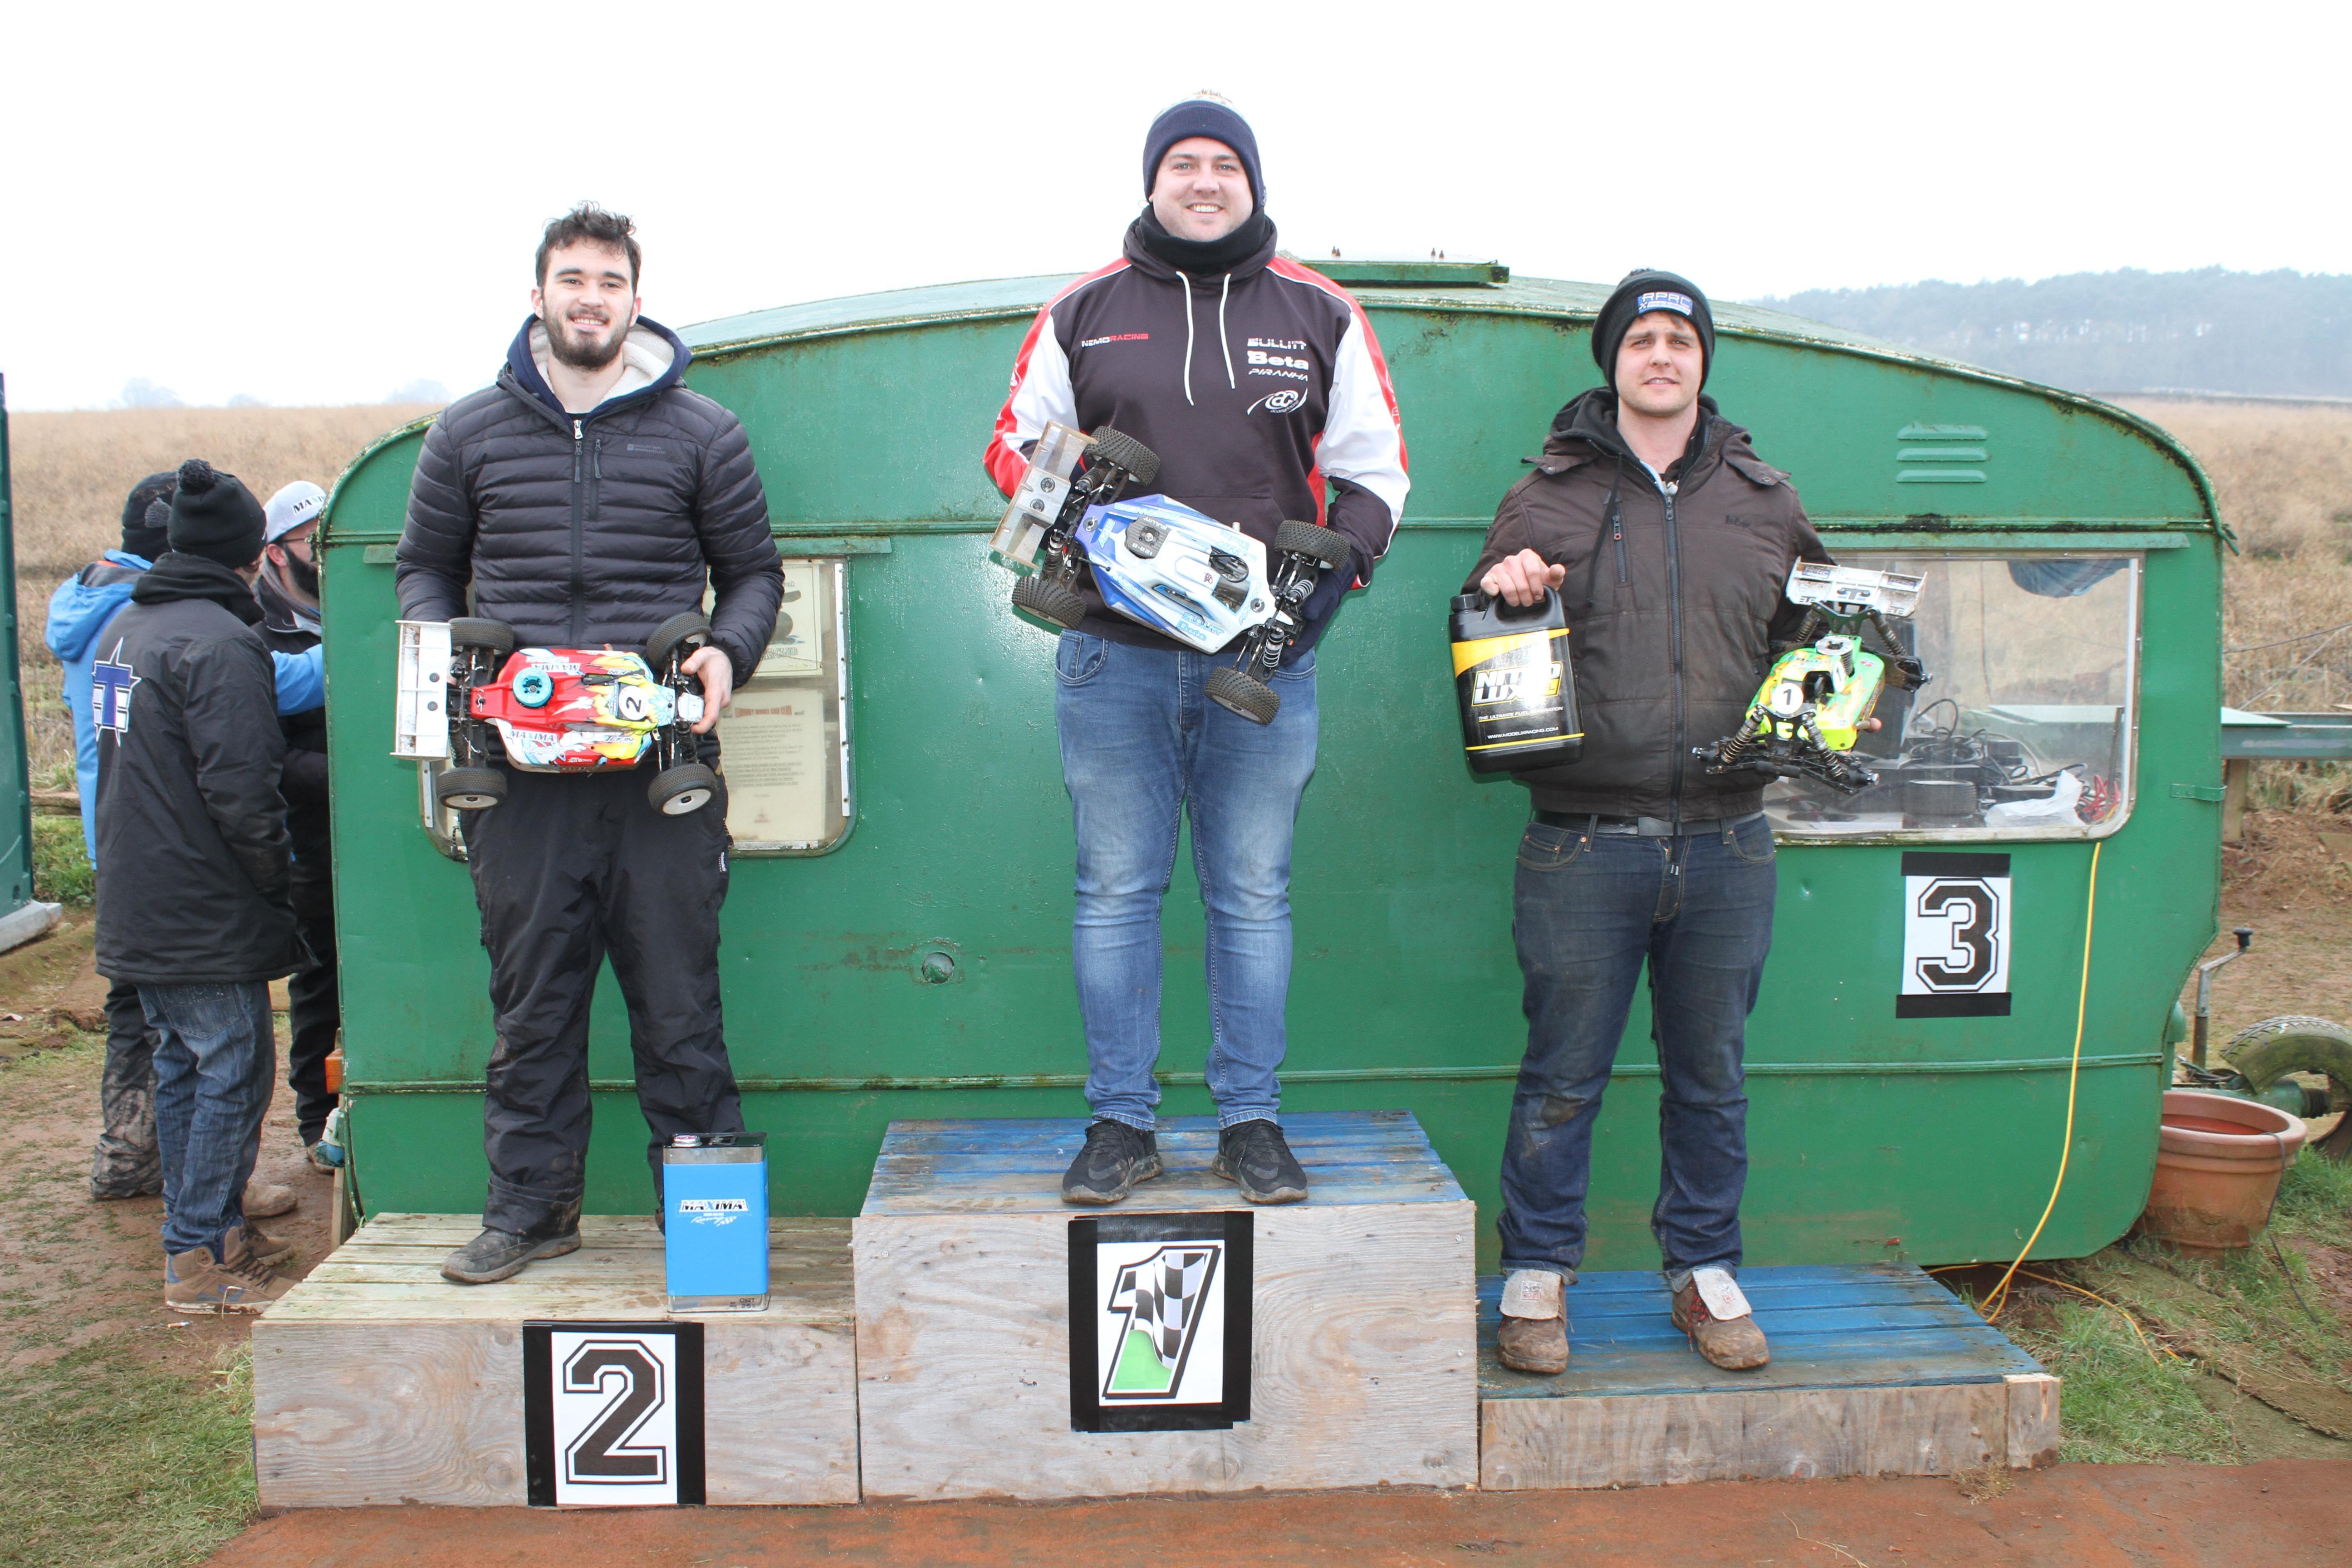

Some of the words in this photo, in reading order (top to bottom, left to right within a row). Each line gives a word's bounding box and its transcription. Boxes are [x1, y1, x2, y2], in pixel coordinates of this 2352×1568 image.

[1082, 333, 1149, 348] NEMORACING
[1247, 350, 1309, 370] Beta
[1248, 368, 1308, 382] PIRANHA
[777, 647, 799, 657] CLUB
[626, 696, 642, 712] 2
[1783, 689, 1792, 705] 1
[510, 730, 554, 741] MAXIMA
[1916, 878, 1999, 993] 3
[681, 1200, 743, 1211] MAXIMA
[1102, 1245, 1221, 1400] 1
[563, 1339, 667, 1485] 2
